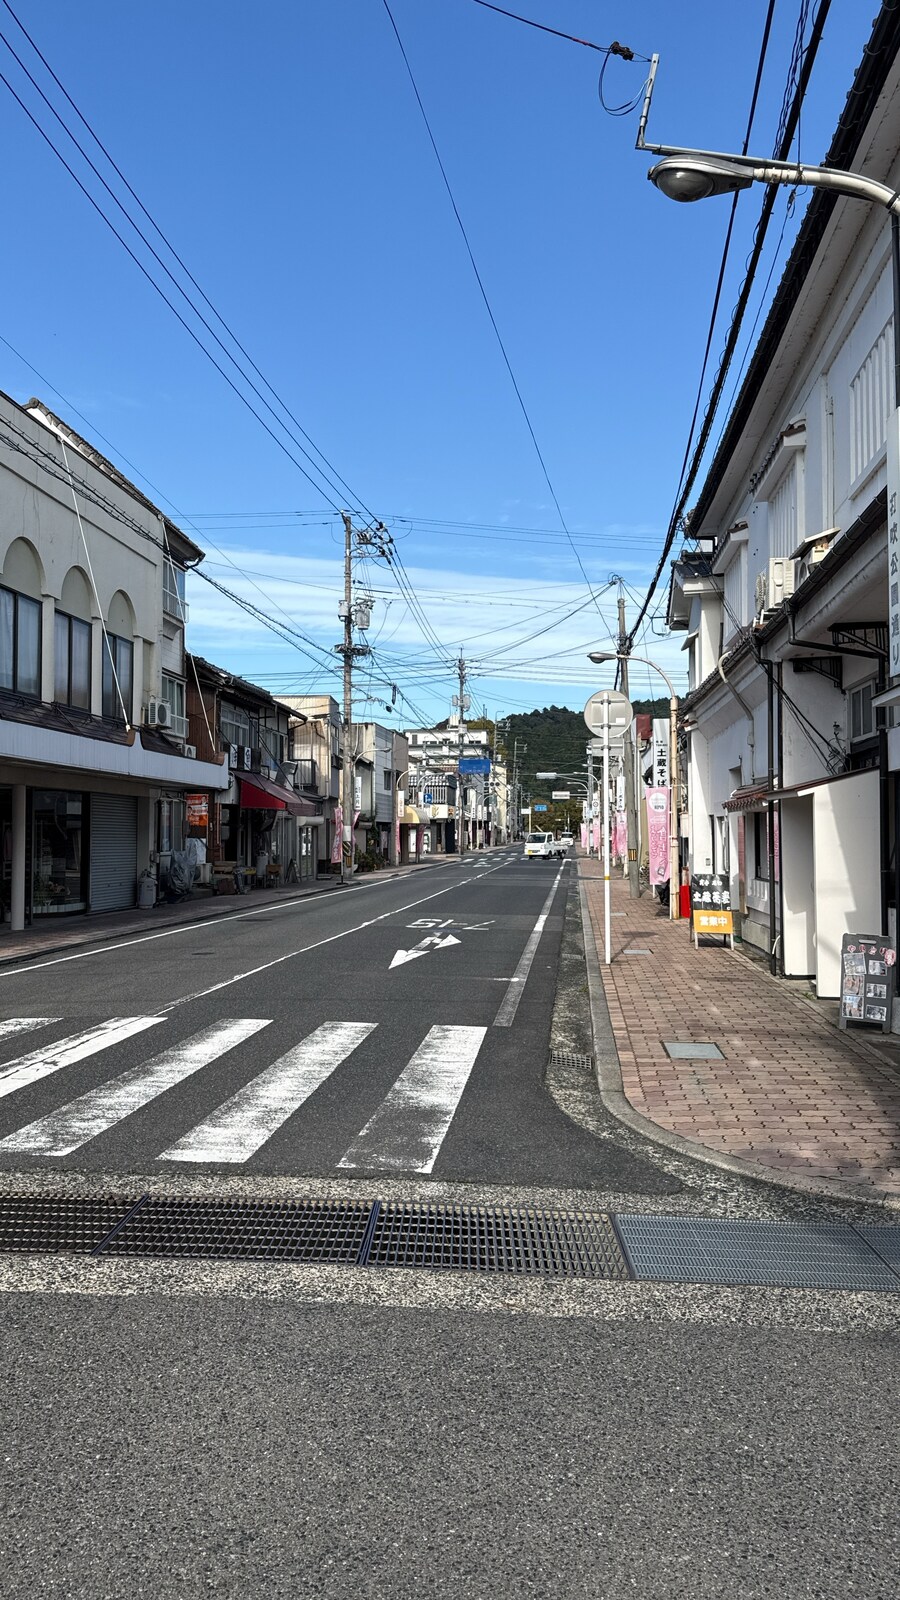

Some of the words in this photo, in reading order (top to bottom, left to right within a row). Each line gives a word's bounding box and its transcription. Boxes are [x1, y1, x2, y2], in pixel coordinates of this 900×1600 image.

[890, 492, 900, 667] 打吹公園通り
[656, 748, 667, 788] 土蔵そば
[699, 916, 728, 927] 営業中
